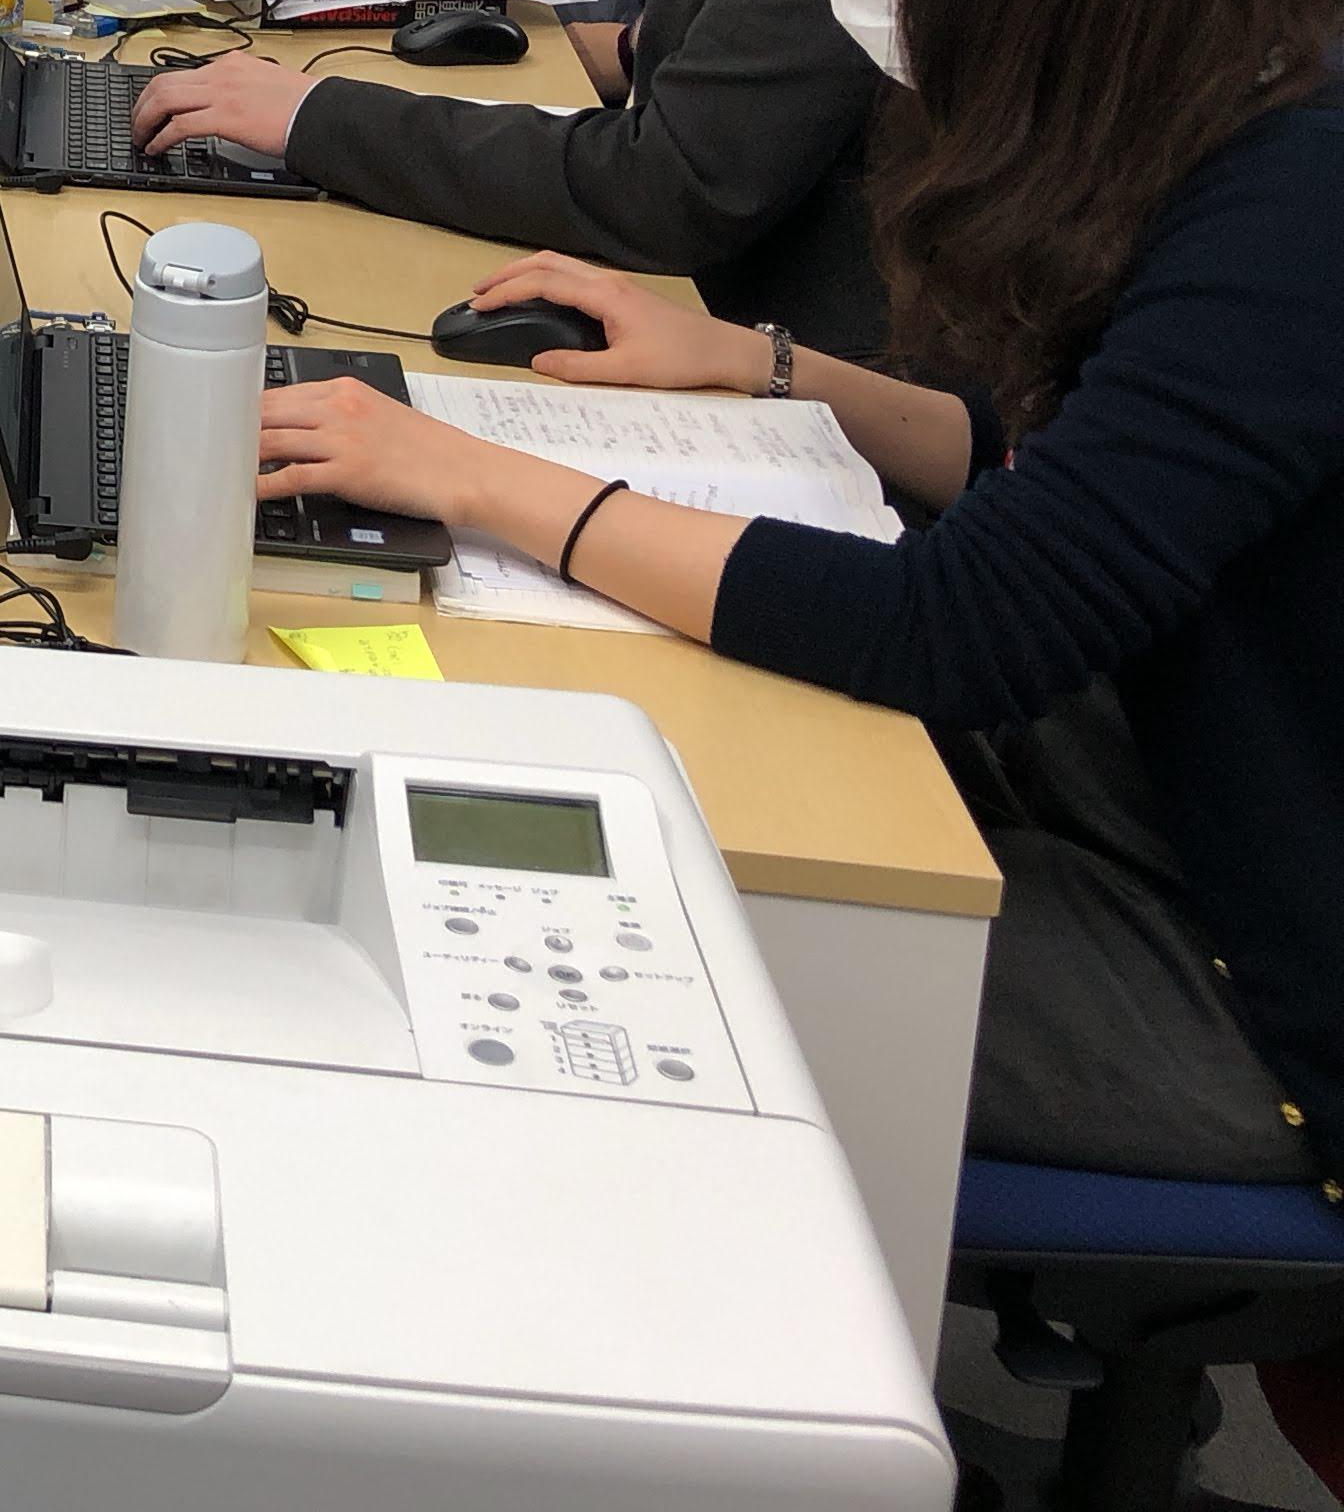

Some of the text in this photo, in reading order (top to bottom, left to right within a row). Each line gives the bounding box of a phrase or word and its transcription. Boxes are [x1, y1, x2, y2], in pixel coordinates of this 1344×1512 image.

[459, 1022, 514, 1034] オンライン
